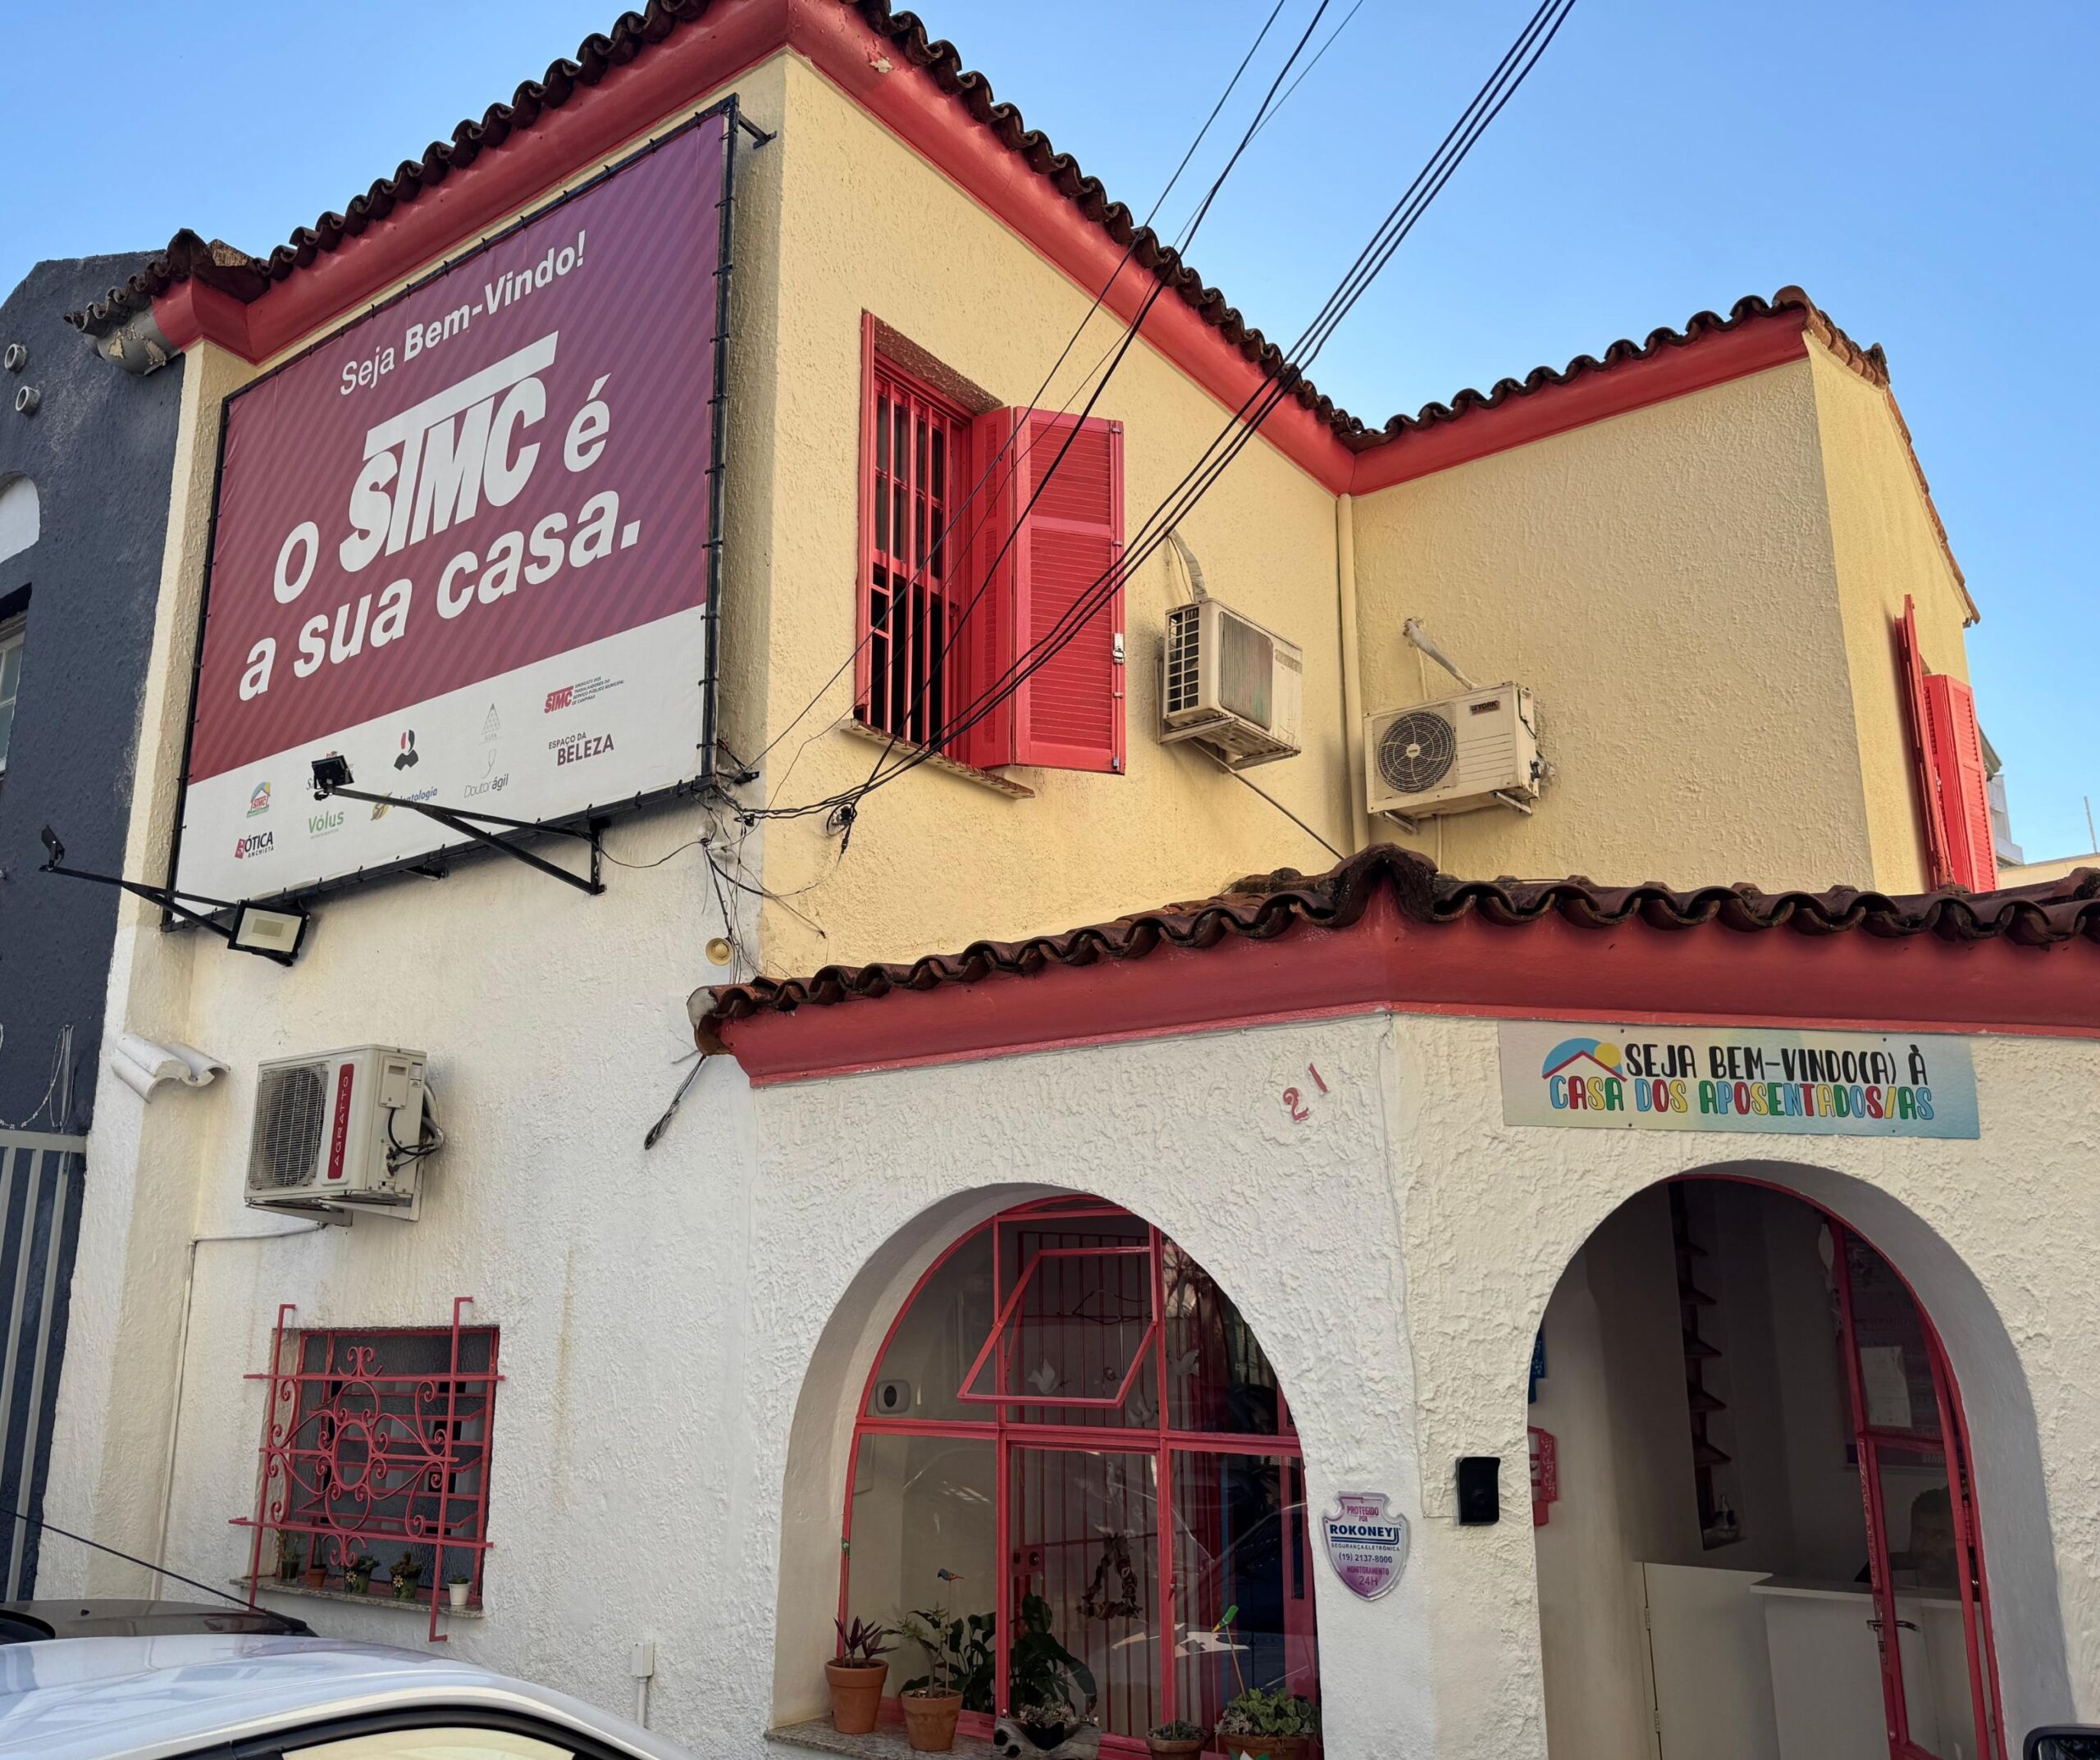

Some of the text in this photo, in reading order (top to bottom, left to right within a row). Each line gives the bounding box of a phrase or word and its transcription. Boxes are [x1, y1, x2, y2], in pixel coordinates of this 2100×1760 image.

[340, 230, 587, 396] Seja Bem-Vindo!
[339, 330, 559, 572] STMC
[564, 372, 612, 472] é
[239, 490, 642, 701] a sua casa.
[544, 685, 574, 714] STMC
[549, 732, 587, 750] ESPAÇO DA
[557, 733, 614, 766] BELEZA
[308, 810, 344, 833] Vólus
[244, 831, 273, 853] ÓTICA
[248, 846, 274, 858] ANCHIETA
[1624, 1043, 1928, 1086] SEJA BEM-VINDO(A) À
[1550, 1075, 1934, 1120] CASA DOS APOSENTADOS/AS
[334, 1076, 348, 1165] AGRATTO
[1347, 1506, 1379, 1516] PROTEGIDO
[1330, 1524, 1392, 1537] ROKONEY
[1339, 1553, 1393, 1564] (19) 2137-8000
[1347, 1566, 1389, 1575] MONITORAMENTO
[1358, 1575, 1378, 1586] 24H
